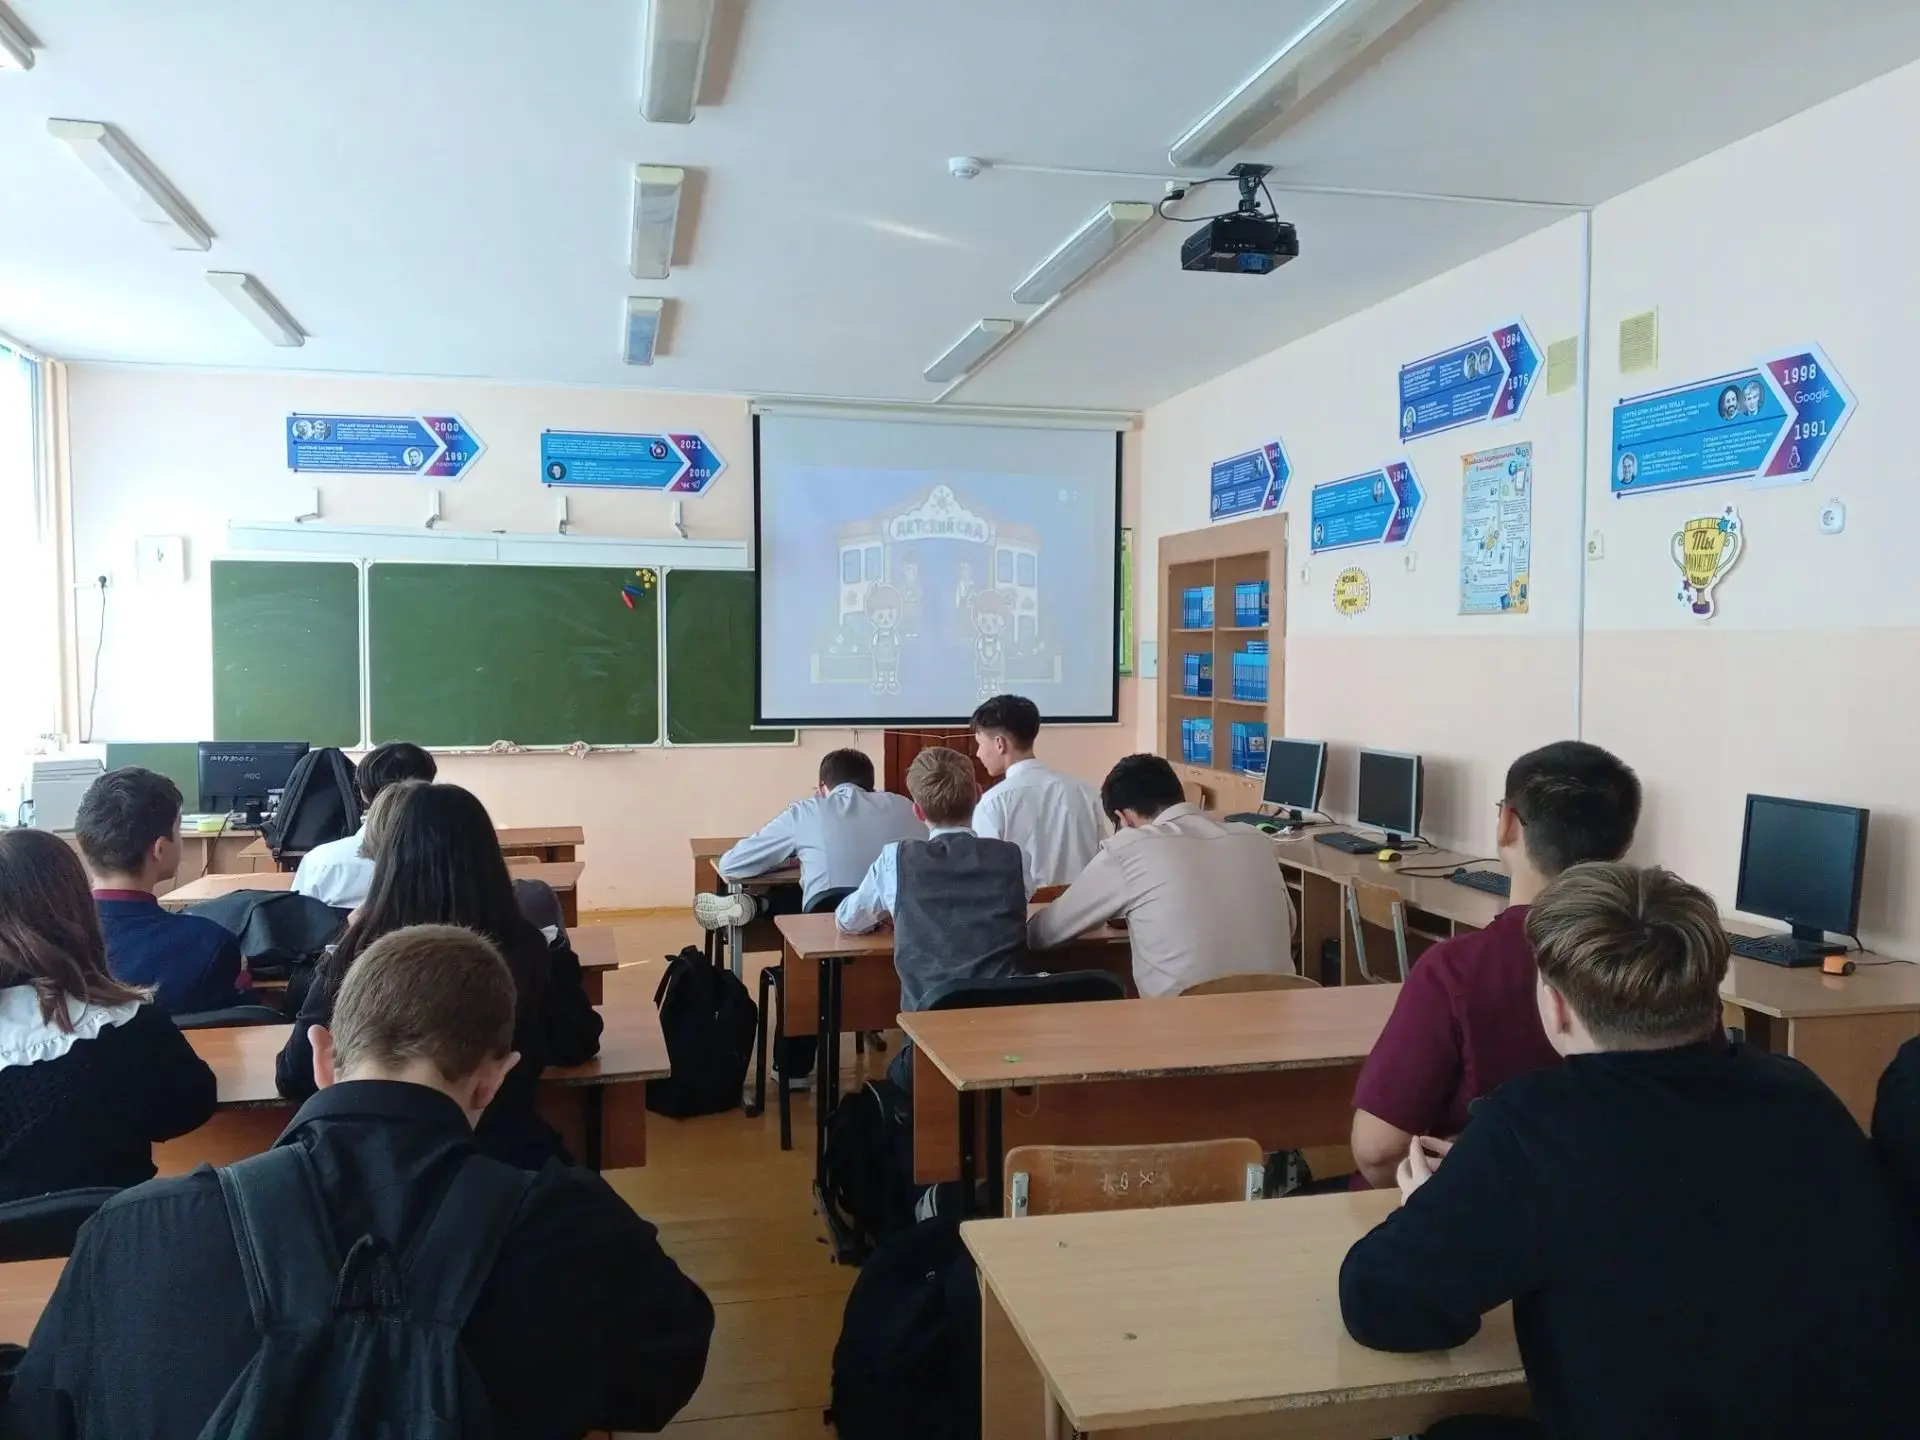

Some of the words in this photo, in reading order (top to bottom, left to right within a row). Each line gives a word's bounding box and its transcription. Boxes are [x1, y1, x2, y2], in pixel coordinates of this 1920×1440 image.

[1502, 332, 1521, 349] 1984
[1508, 373, 1529, 390] 1976
[1783, 363, 1817, 385] 1998
[1794, 387, 1830, 403] Google
[434, 422, 459, 432] 2000
[1794, 419, 1828, 440] 1991
[680, 439, 701, 449] 2021
[1393, 469, 1409, 482] 1947
[1397, 506, 1414, 520] 1936
[897, 516, 954, 537] ДЕТСКИЙ
[1692, 529, 1715, 550] Ты
